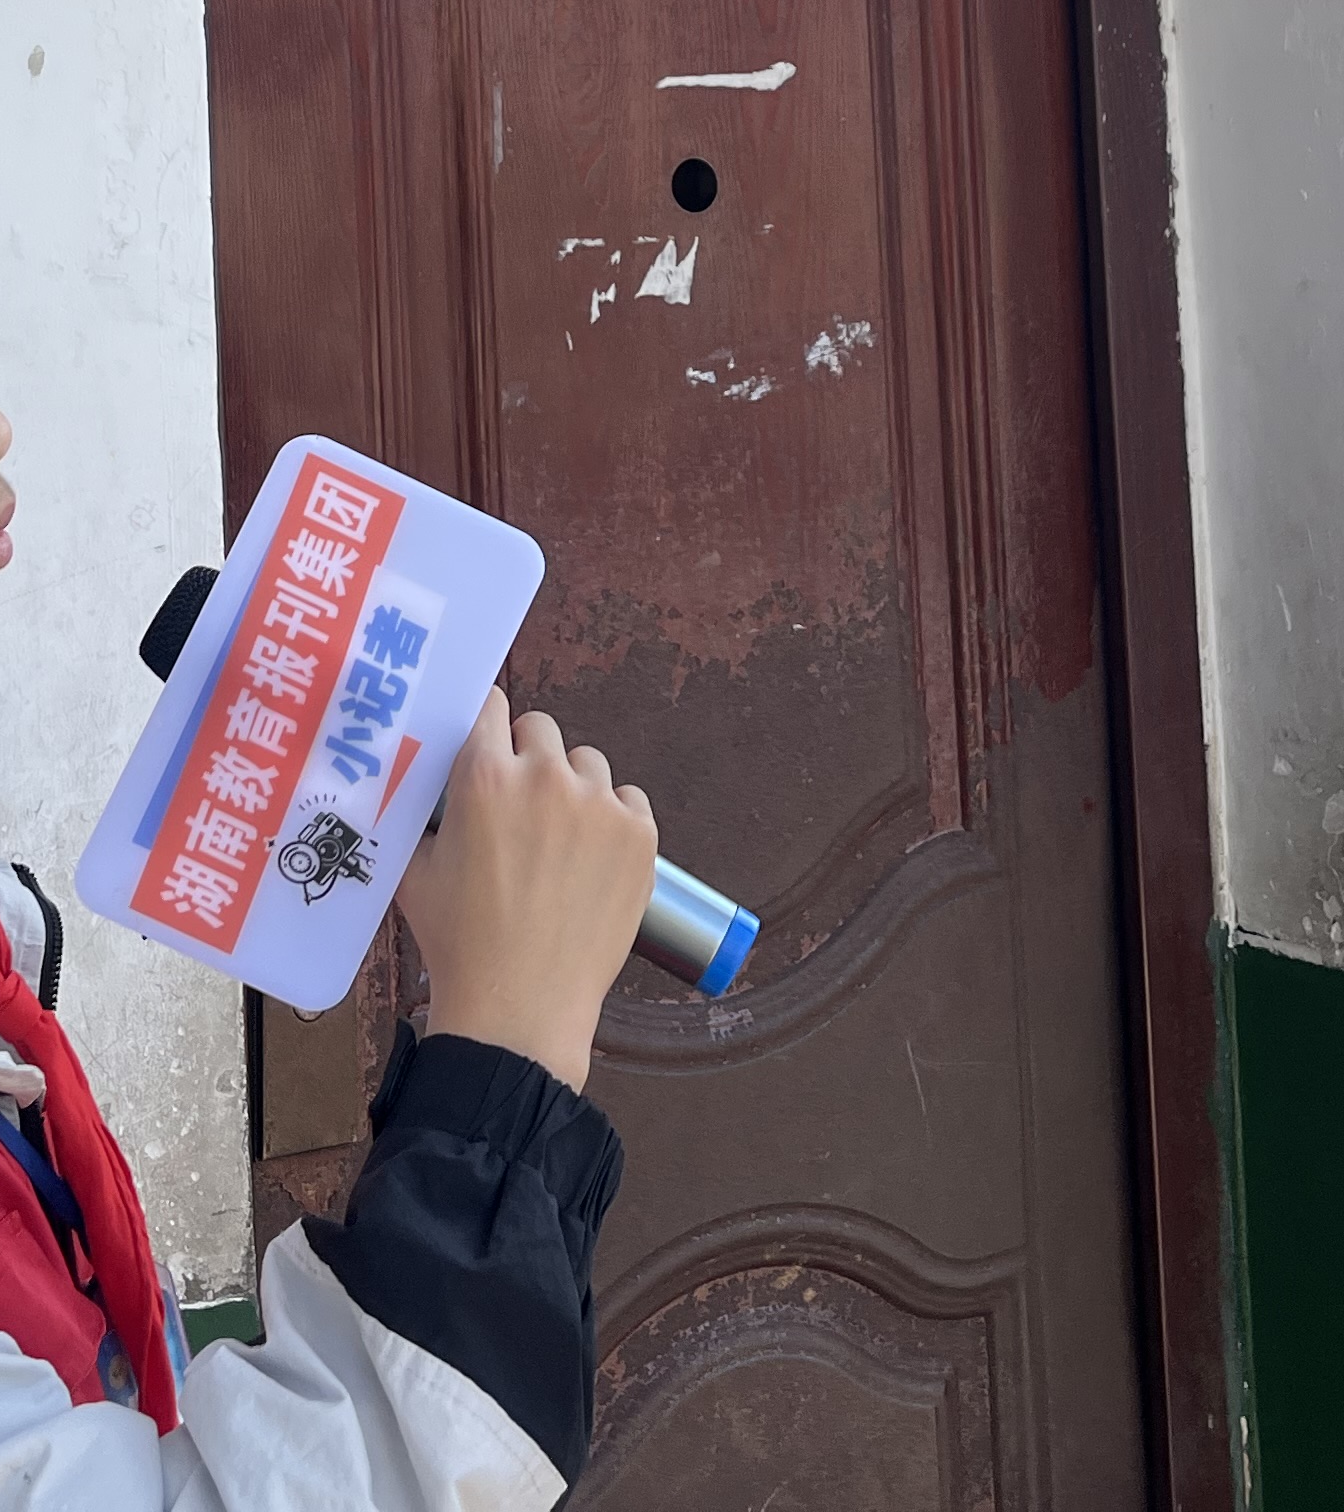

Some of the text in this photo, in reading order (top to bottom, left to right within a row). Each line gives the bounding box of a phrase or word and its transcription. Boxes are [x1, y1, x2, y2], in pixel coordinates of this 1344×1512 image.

[160, 469, 382, 931] 湖南教育报刊集团
[324, 601, 430, 787] 小记者
